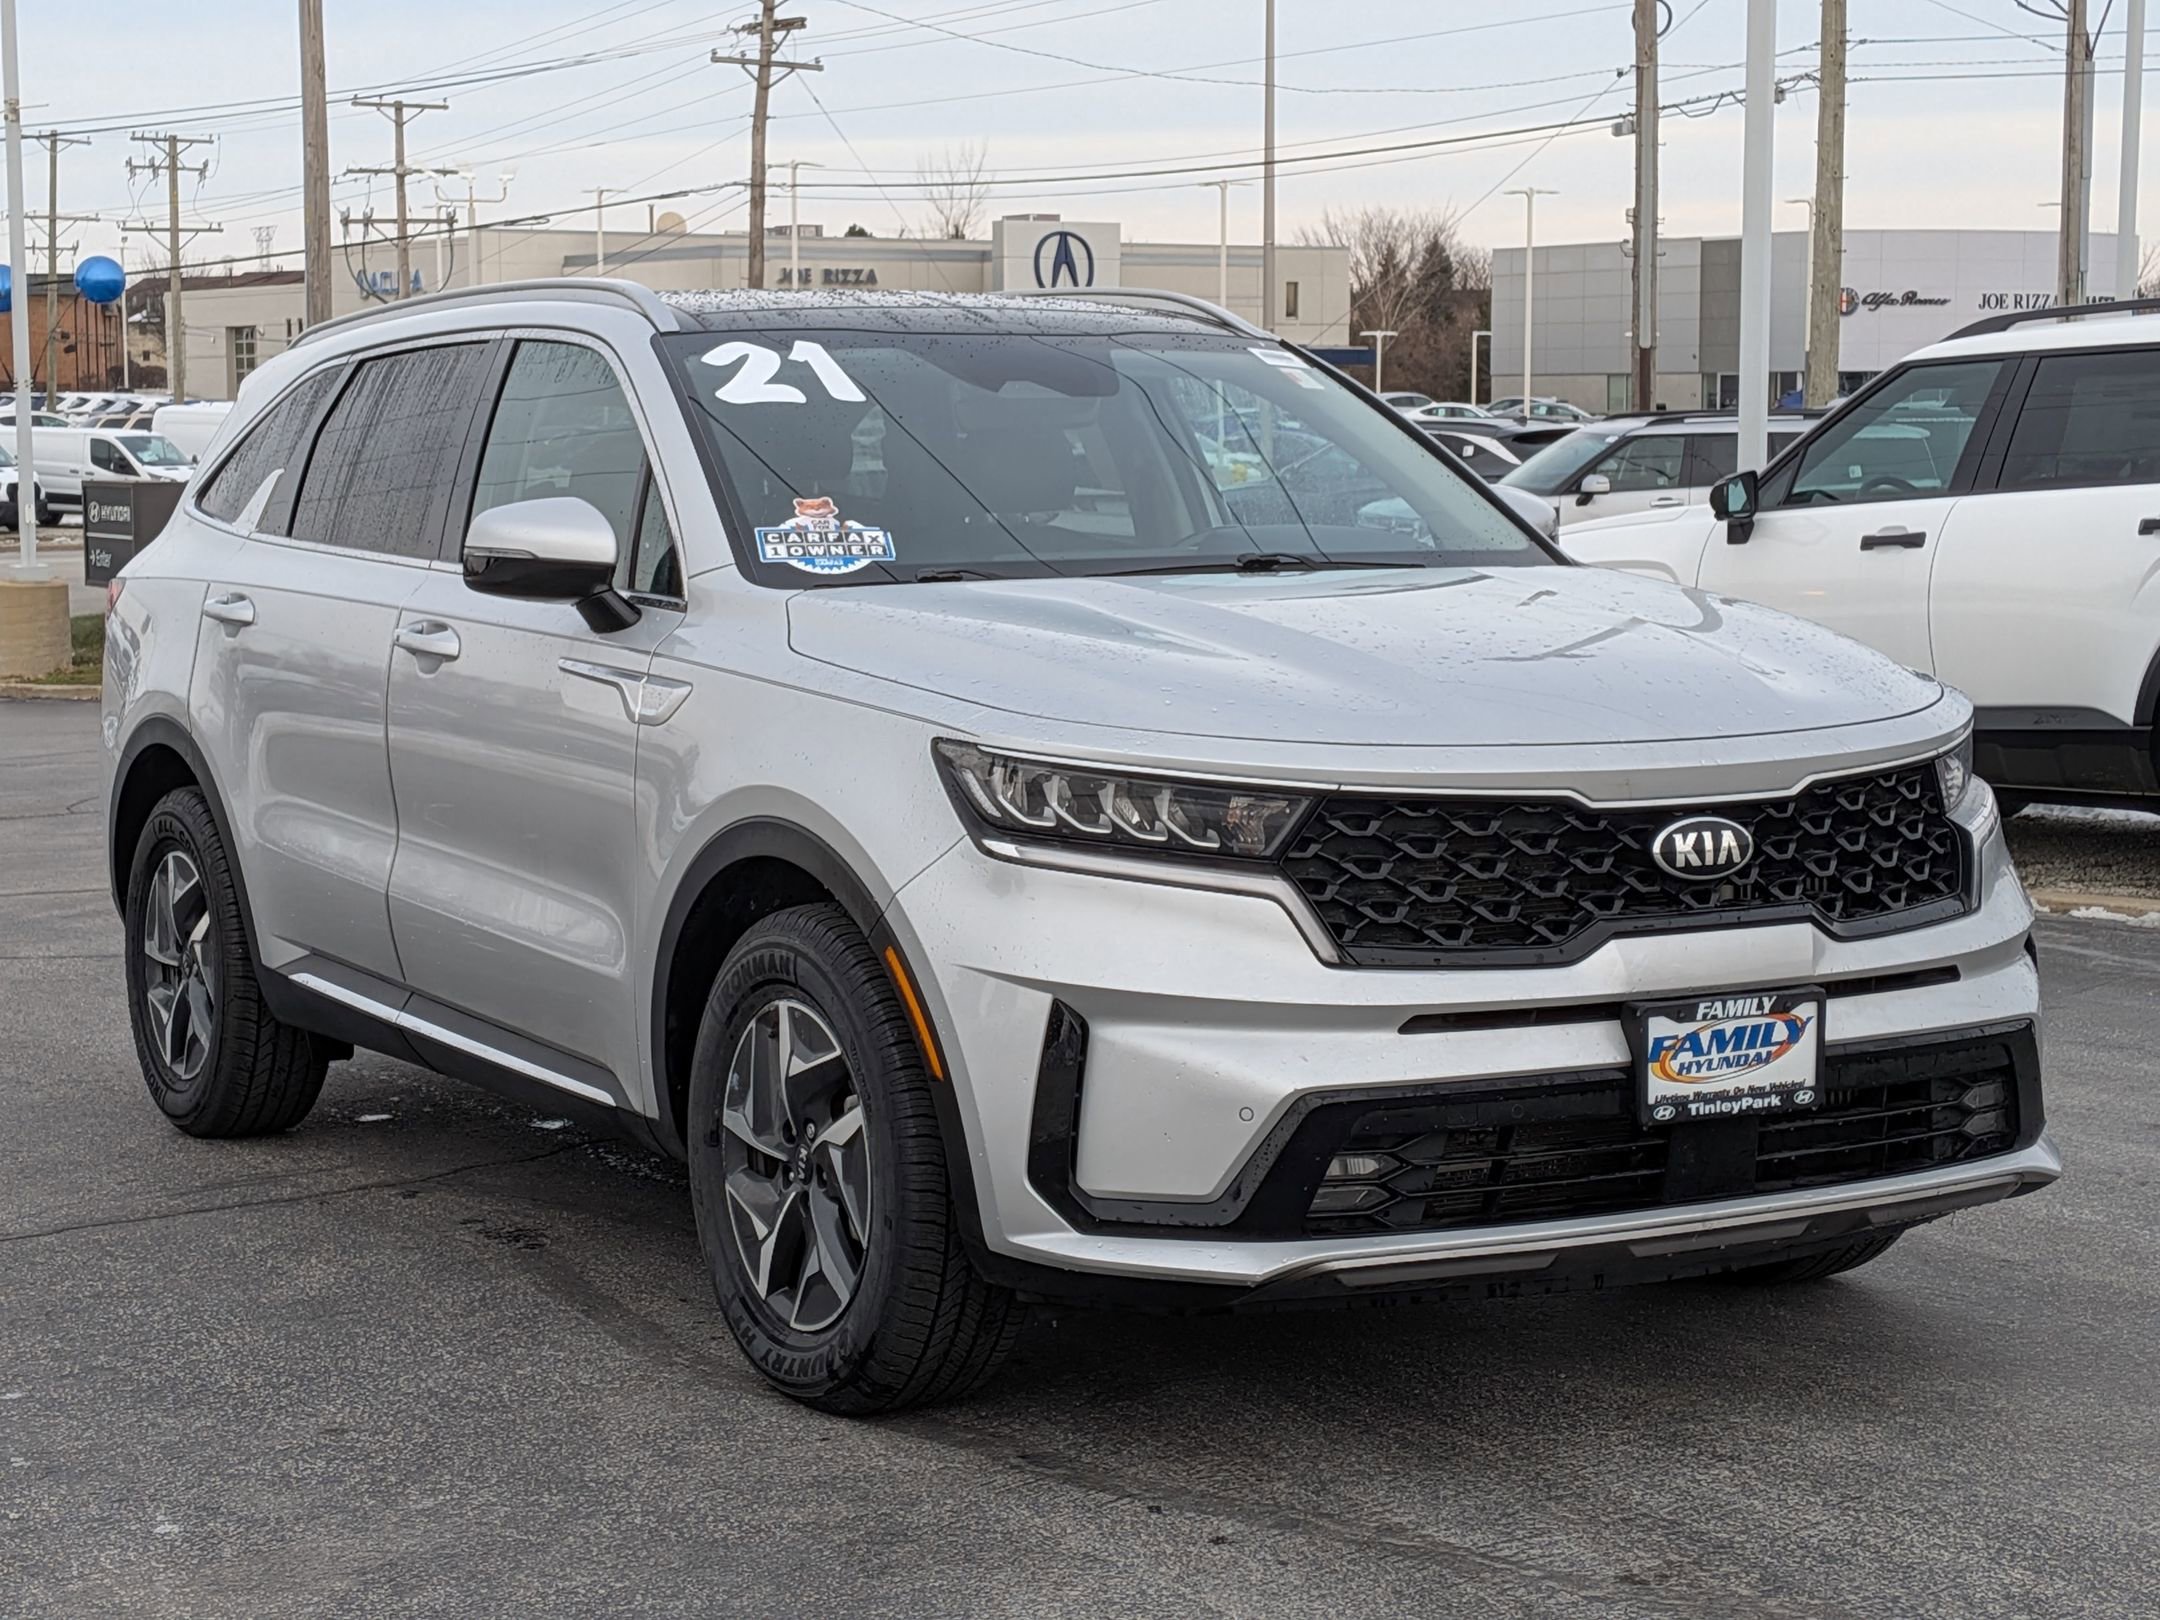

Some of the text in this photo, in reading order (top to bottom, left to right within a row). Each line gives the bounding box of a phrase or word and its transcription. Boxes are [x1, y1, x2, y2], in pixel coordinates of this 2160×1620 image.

[777, 267, 878, 285] JOE RIZZA
[1861, 291, 1899, 311] Alfa
[1900, 290, 1951, 306] Romeo
[1978, 293, 2009, 310] JOE
[700, 339, 867, 404] 21
[766, 531, 881, 544] CARFAX
[769, 545, 884, 556] 1 OWNER
[1672, 829, 1741, 868] KIA
[1696, 996, 1777, 1021] FAMILY
[1648, 1016, 1814, 1063] FAMILY
[1676, 1051, 1773, 1076] HYUNDAI
[1688, 1094, 1781, 1117] TinleyPark
